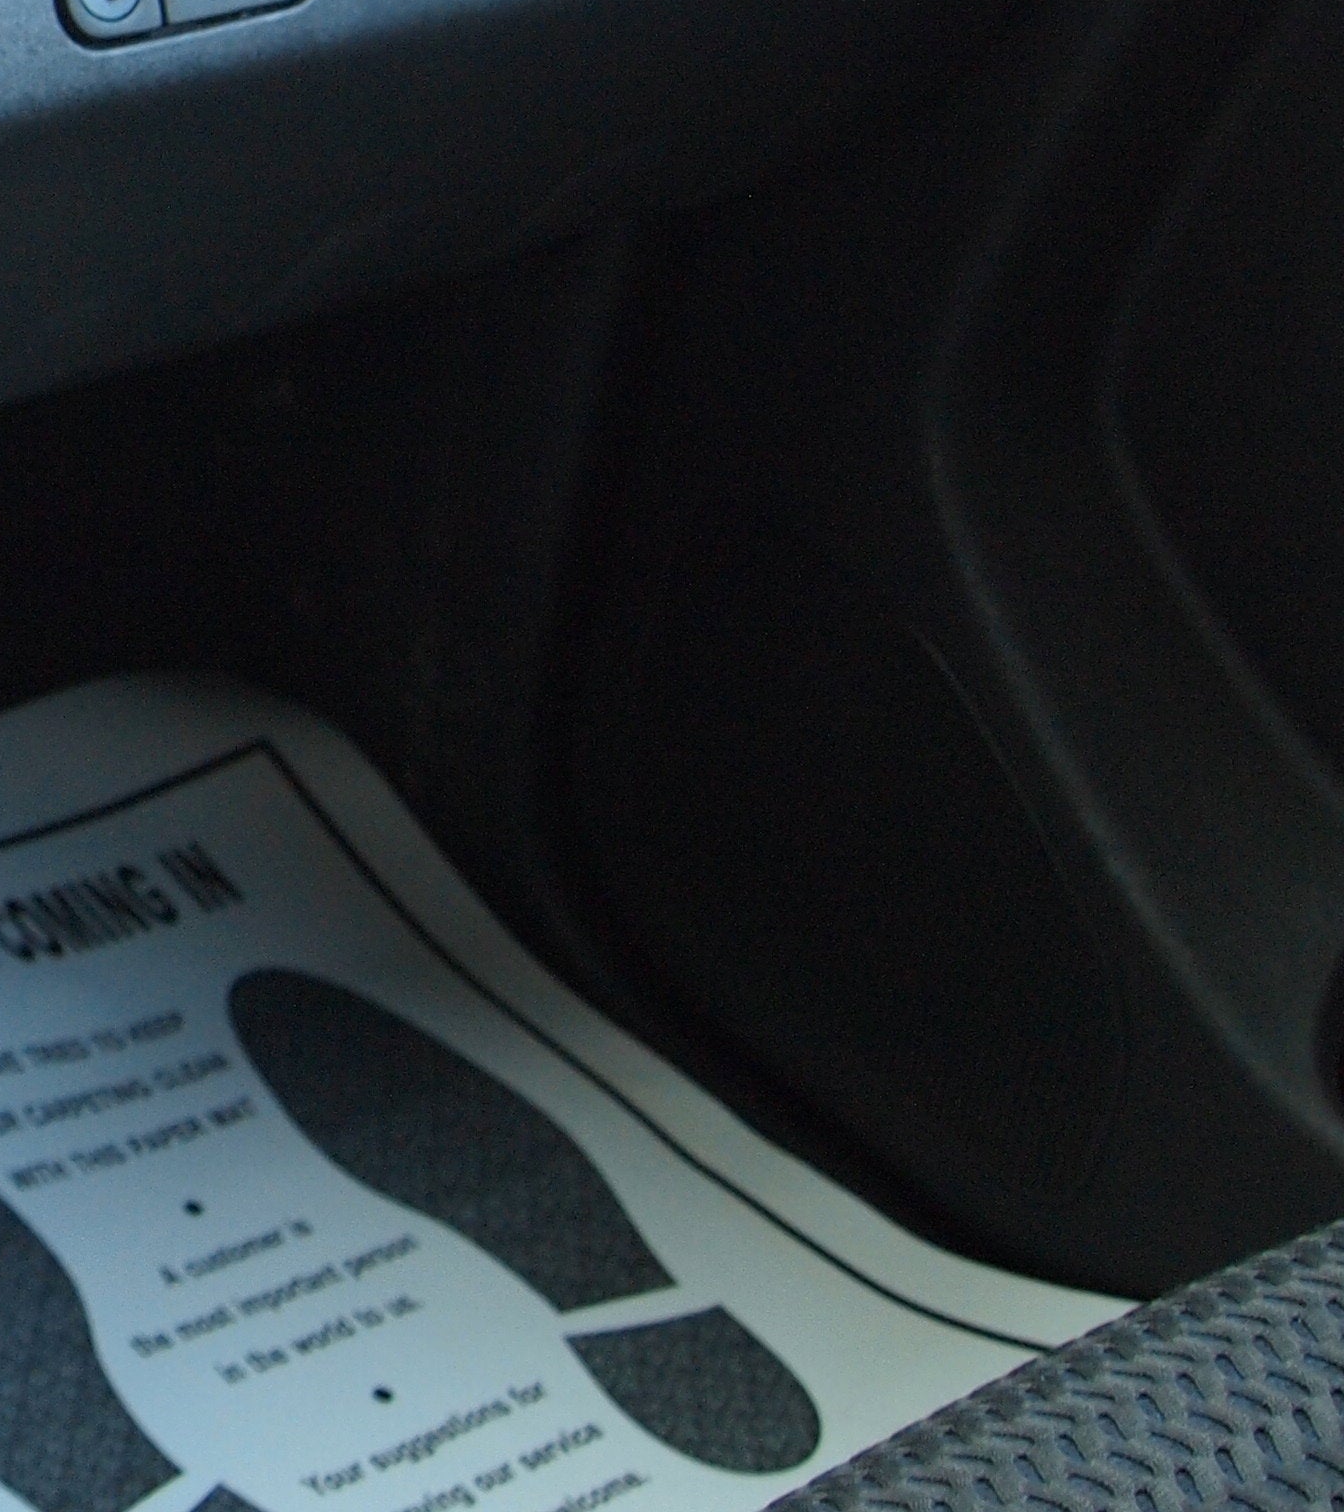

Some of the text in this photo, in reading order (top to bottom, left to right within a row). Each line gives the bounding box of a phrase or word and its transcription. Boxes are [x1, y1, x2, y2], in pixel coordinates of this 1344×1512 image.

[157, 839, 244, 918] IN
[183, 1228, 286, 1279] customer
[129, 1232, 419, 1359] the most important person
[243, 1347, 291, 1375] the
[291, 1314, 358, 1356] world
[353, 1306, 387, 1330] to
[300, 1379, 546, 1496] Your suggestions for
[475, 1462, 515, 1492] our
[517, 1422, 605, 1471] service
